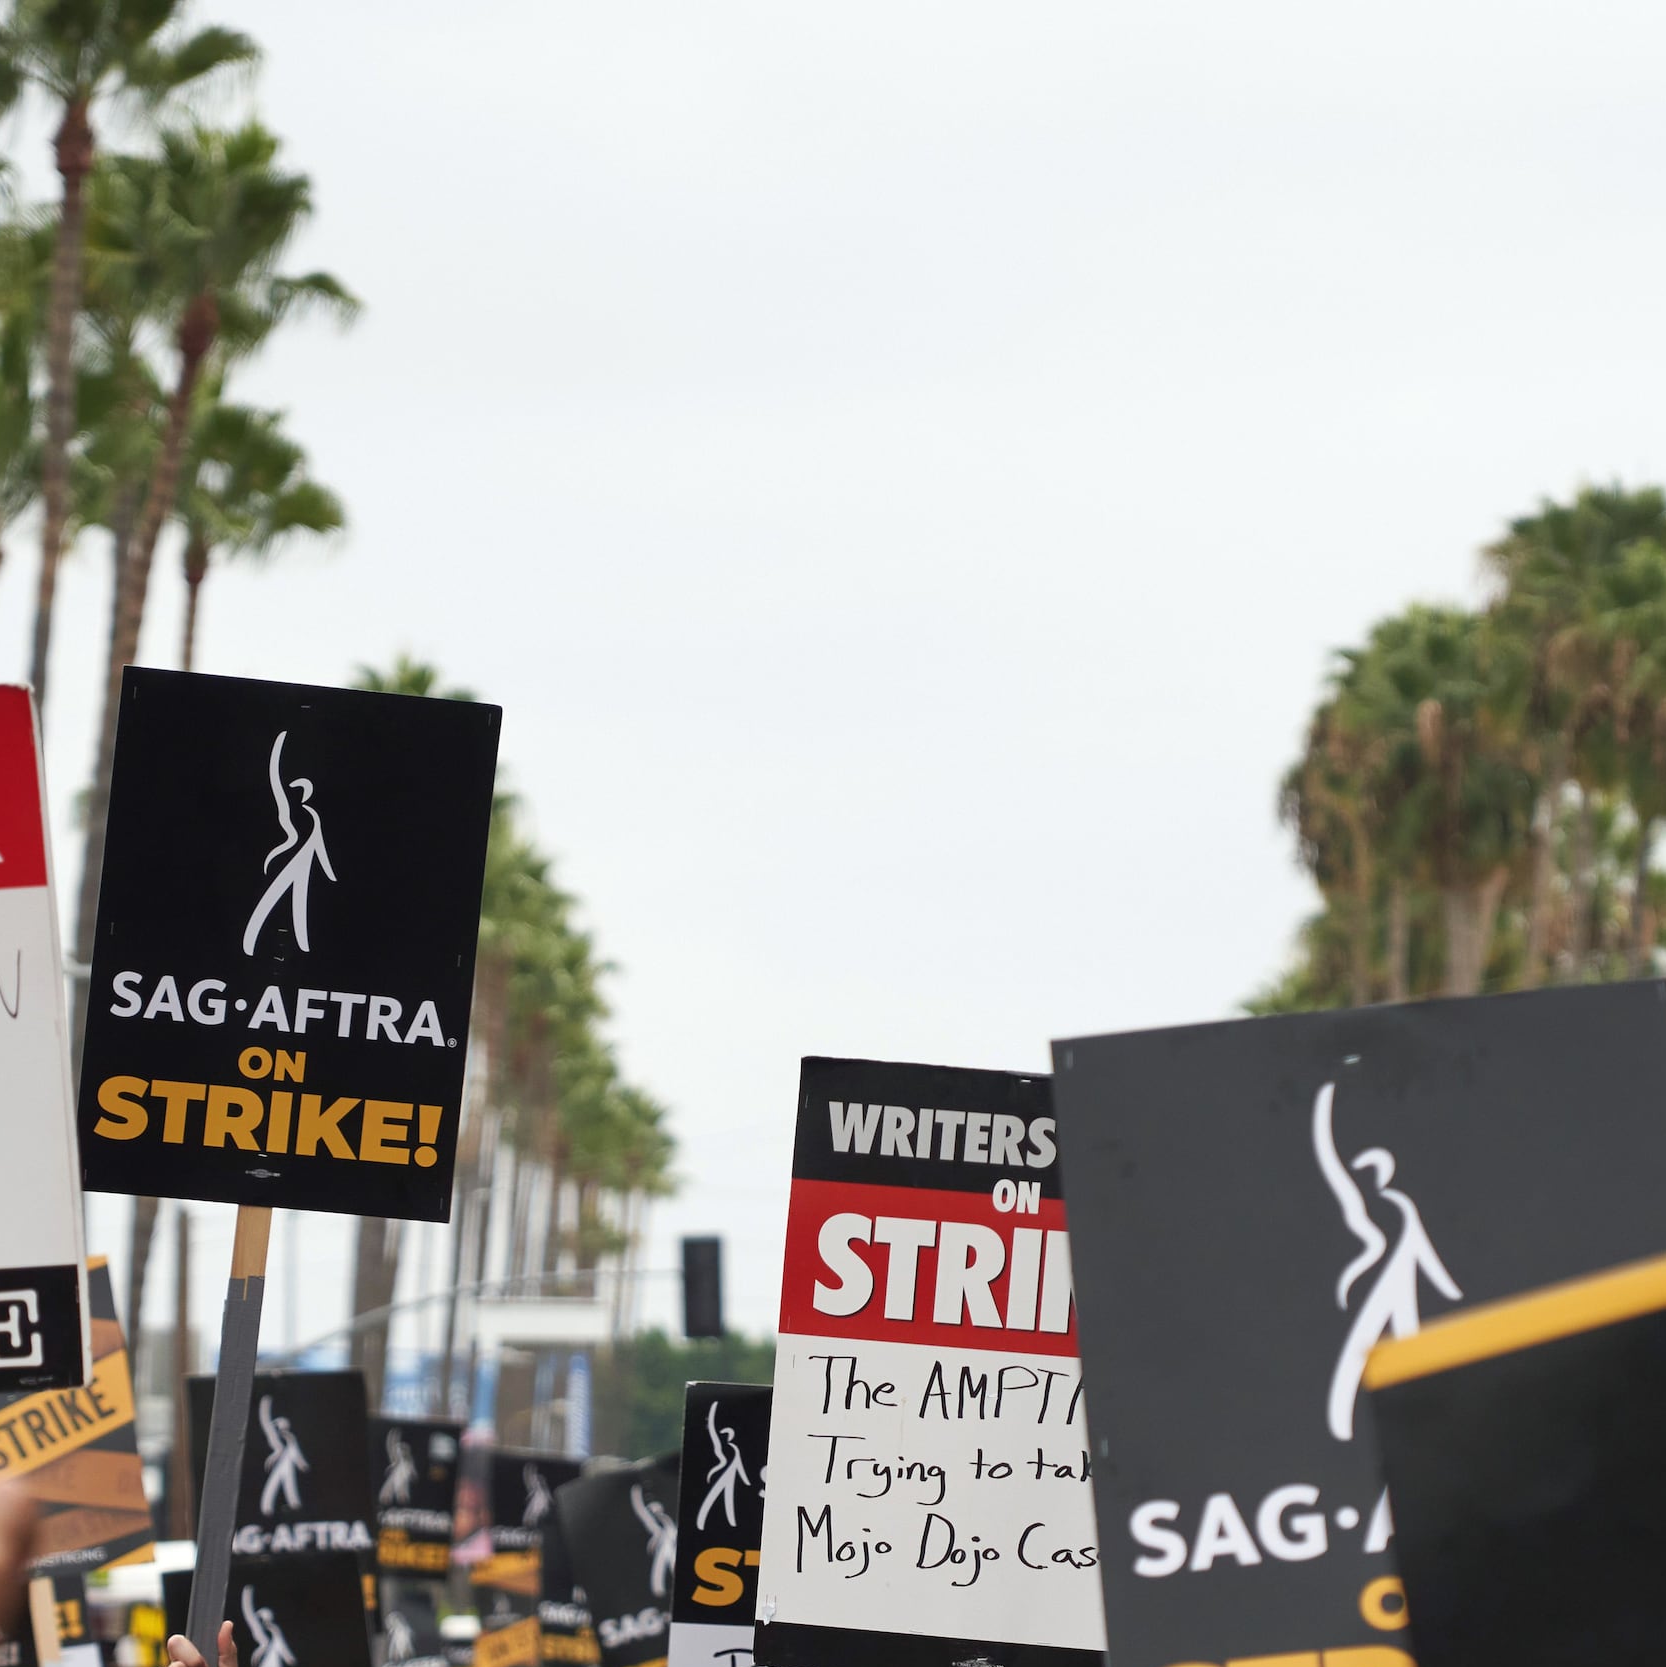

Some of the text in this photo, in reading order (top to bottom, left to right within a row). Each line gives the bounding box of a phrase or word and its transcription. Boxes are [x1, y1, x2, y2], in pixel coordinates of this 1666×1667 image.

[238, 1046, 306, 1083] ON
[93, 1075, 443, 1168] STRIKE!
[829, 1100, 1058, 1169] WRITERS
[992, 1178, 1040, 1215] ON
[813, 1212, 1073, 1335] STRI
[808, 1355, 898, 1414] The
[807, 1434, 946, 1506] Trying
[968, 1448, 1013, 1480] to
[797, 1504, 892, 1580] Mojo
[916, 1513, 1000, 1588] Dojo
[1017, 1522, 1101, 1571] Cas
